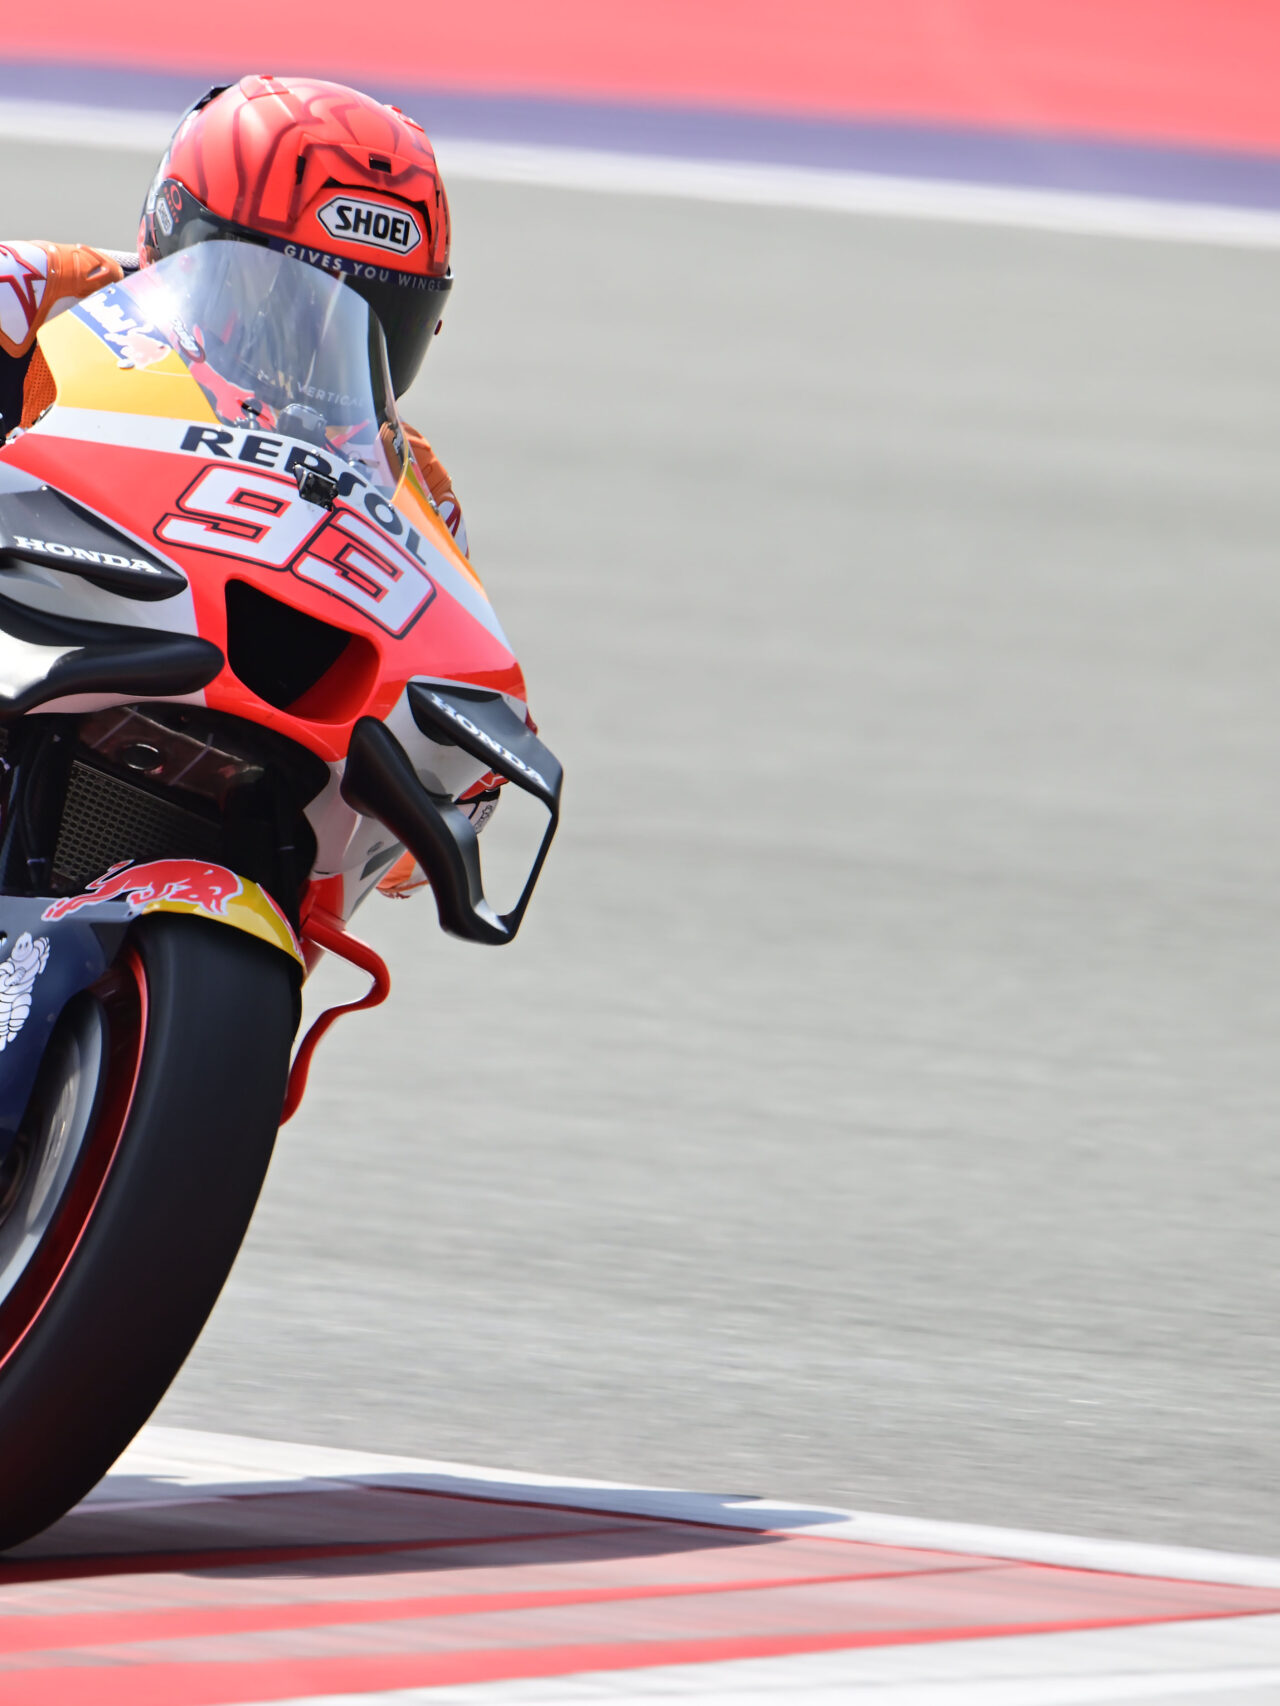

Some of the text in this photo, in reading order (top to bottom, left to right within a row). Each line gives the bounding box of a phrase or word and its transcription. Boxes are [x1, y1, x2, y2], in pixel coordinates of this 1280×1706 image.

[334, 204, 411, 247] SHOEI
[284, 244, 442, 293] GIVES YOU WINGS
[13, 535, 162, 575] HONDA
[152, 463, 438, 641] 93
[431, 692, 552, 792] HONDA
